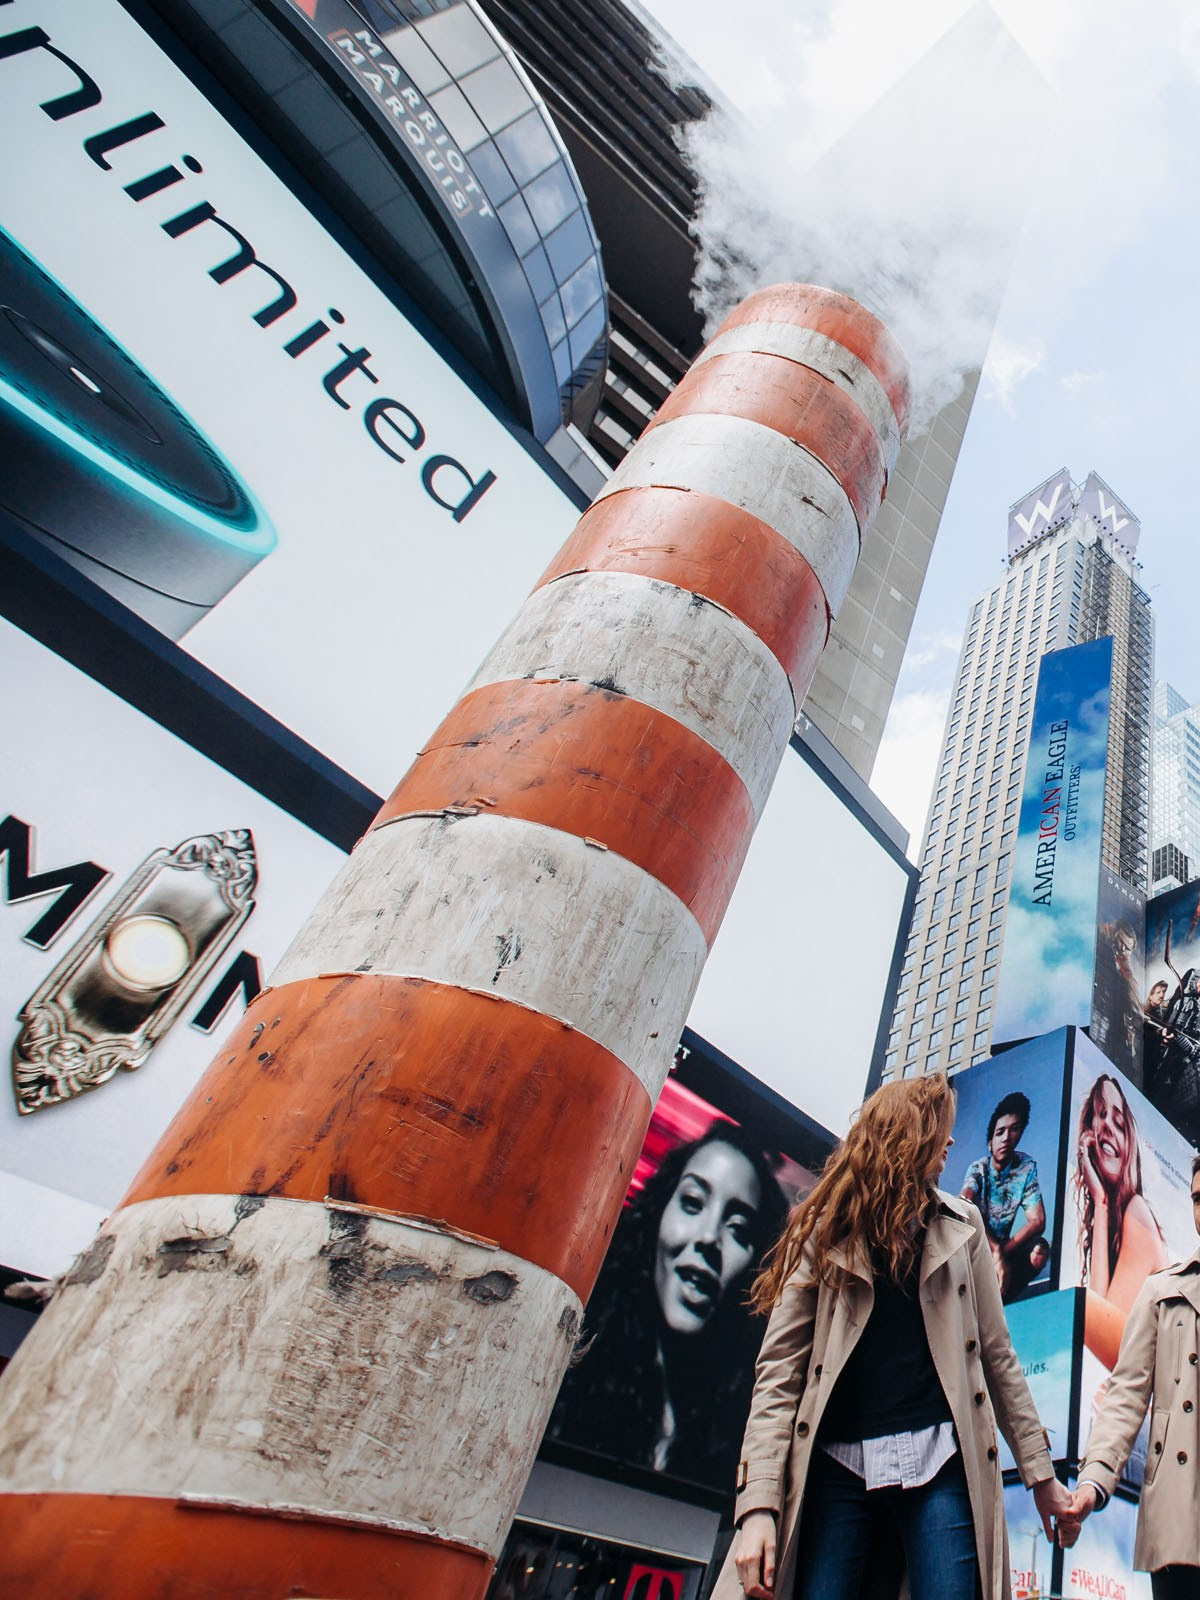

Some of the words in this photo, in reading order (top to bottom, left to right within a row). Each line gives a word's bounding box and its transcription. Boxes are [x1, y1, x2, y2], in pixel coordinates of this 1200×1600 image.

[337, 37, 467, 211] MARQUIS
[355, 29, 494, 218] MARRIOTT
[0, 0, 496, 523] nlimited
[1014, 482, 1064, 536] W
[1098, 488, 1130, 533] W
[1044, 719, 1069, 784] EAGLE
[1063, 764, 1081, 842] OUTFITTERS
[1031, 786, 1062, 907] AMERICAN
[1022, 1361, 1049, 1377] ules.
